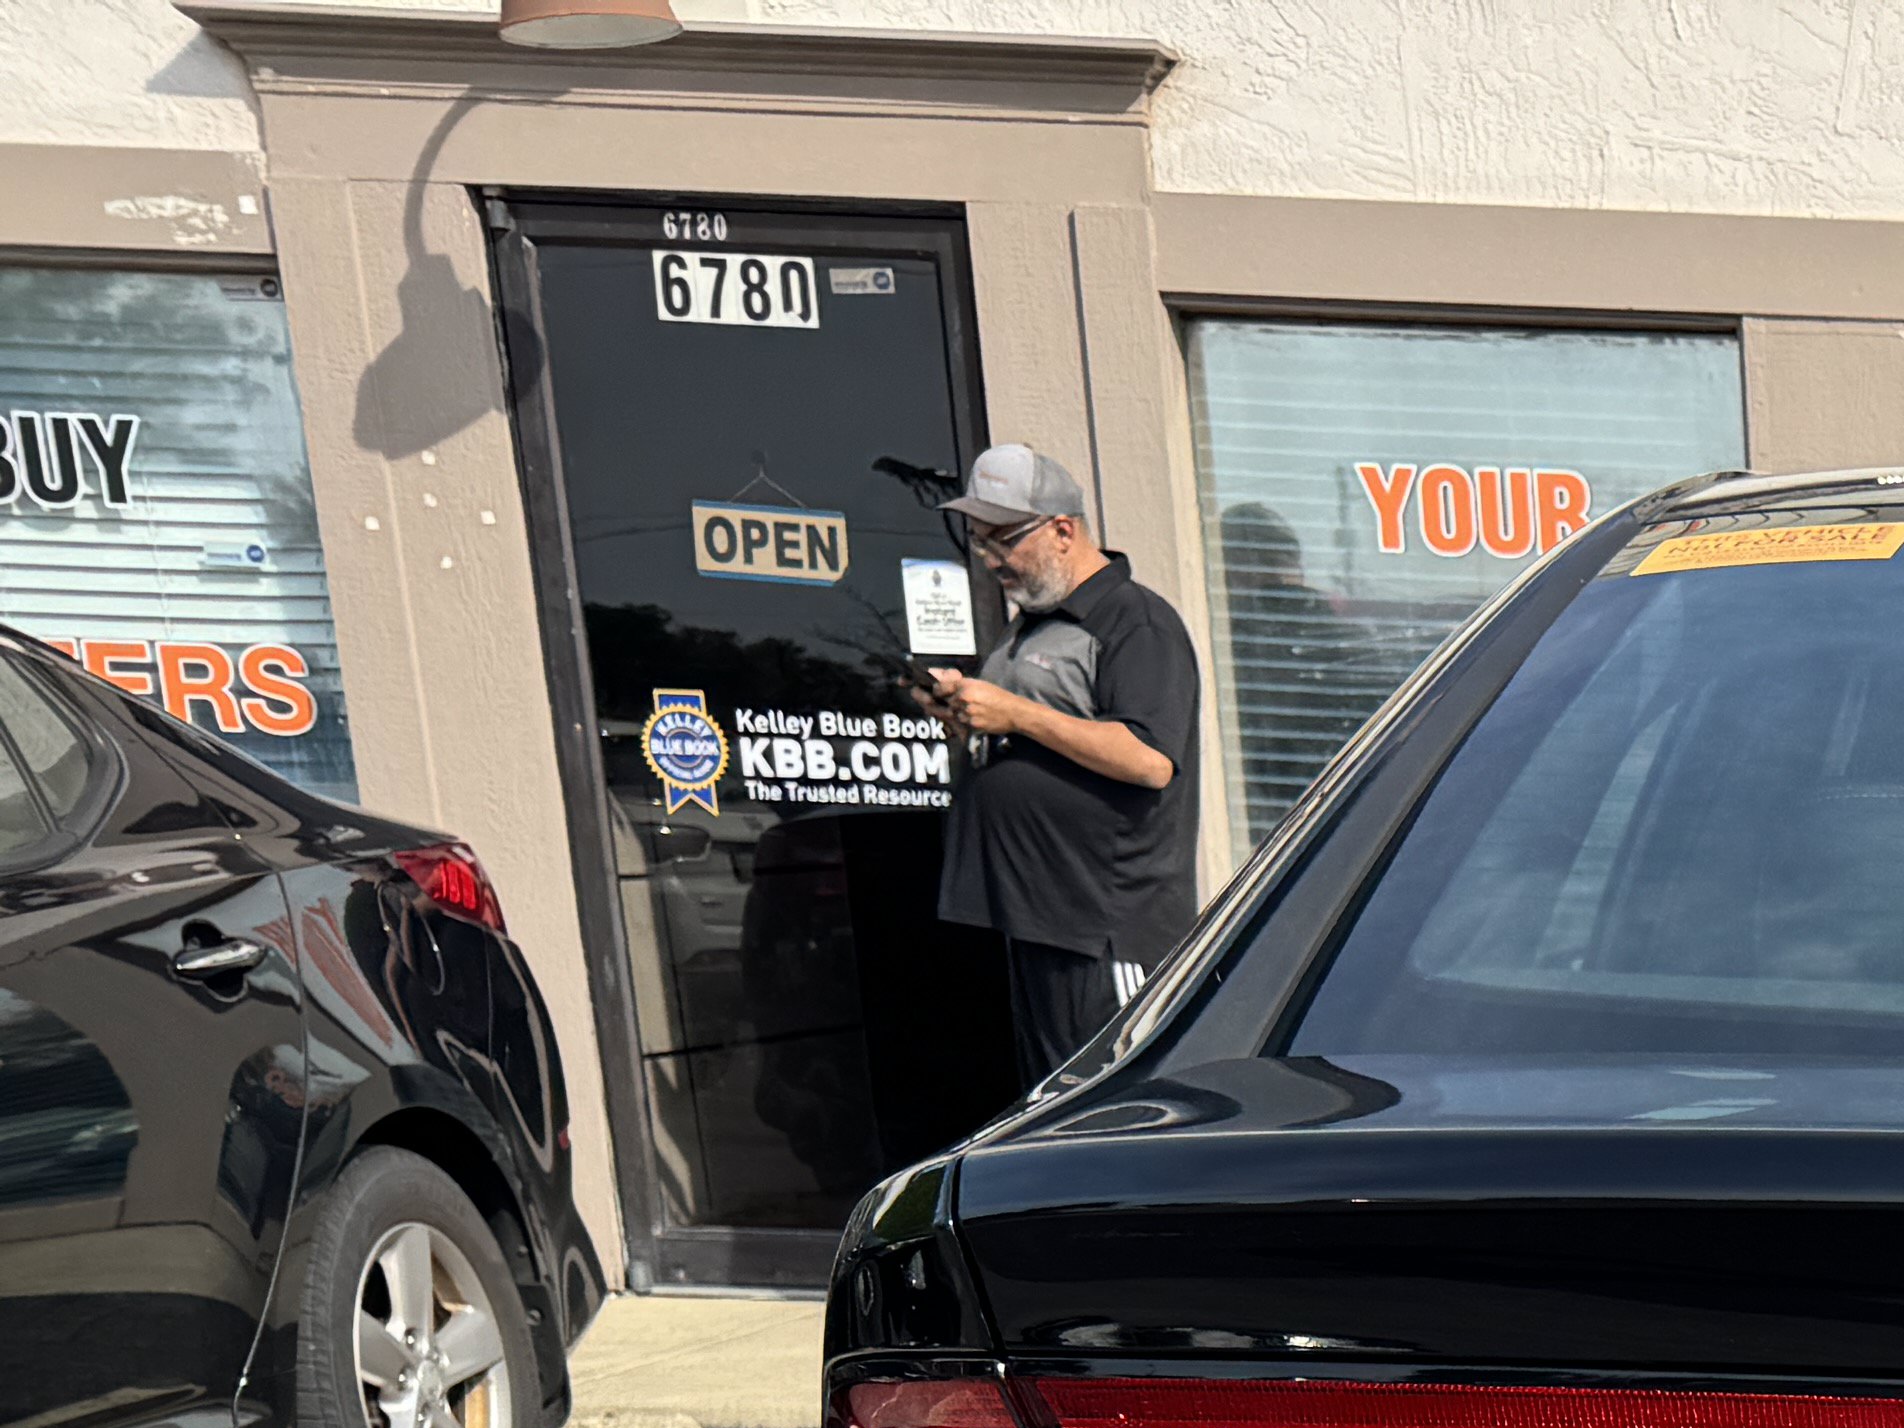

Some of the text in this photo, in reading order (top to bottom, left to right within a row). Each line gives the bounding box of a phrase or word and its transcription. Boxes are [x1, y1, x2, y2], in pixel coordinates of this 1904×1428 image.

[662, 211, 727, 241] 6780
[660, 254, 812, 324] 6780
[0, 410, 140, 509] UY
[1354, 463, 1591, 558] YOUR
[703, 515, 841, 573] OPEN
[40, 637, 318, 736] ERS
[735, 708, 947, 740] Kelley Blue Book
[739, 736, 951, 785] KBB.COM
[744, 780, 952, 808] The Trusted Resource
